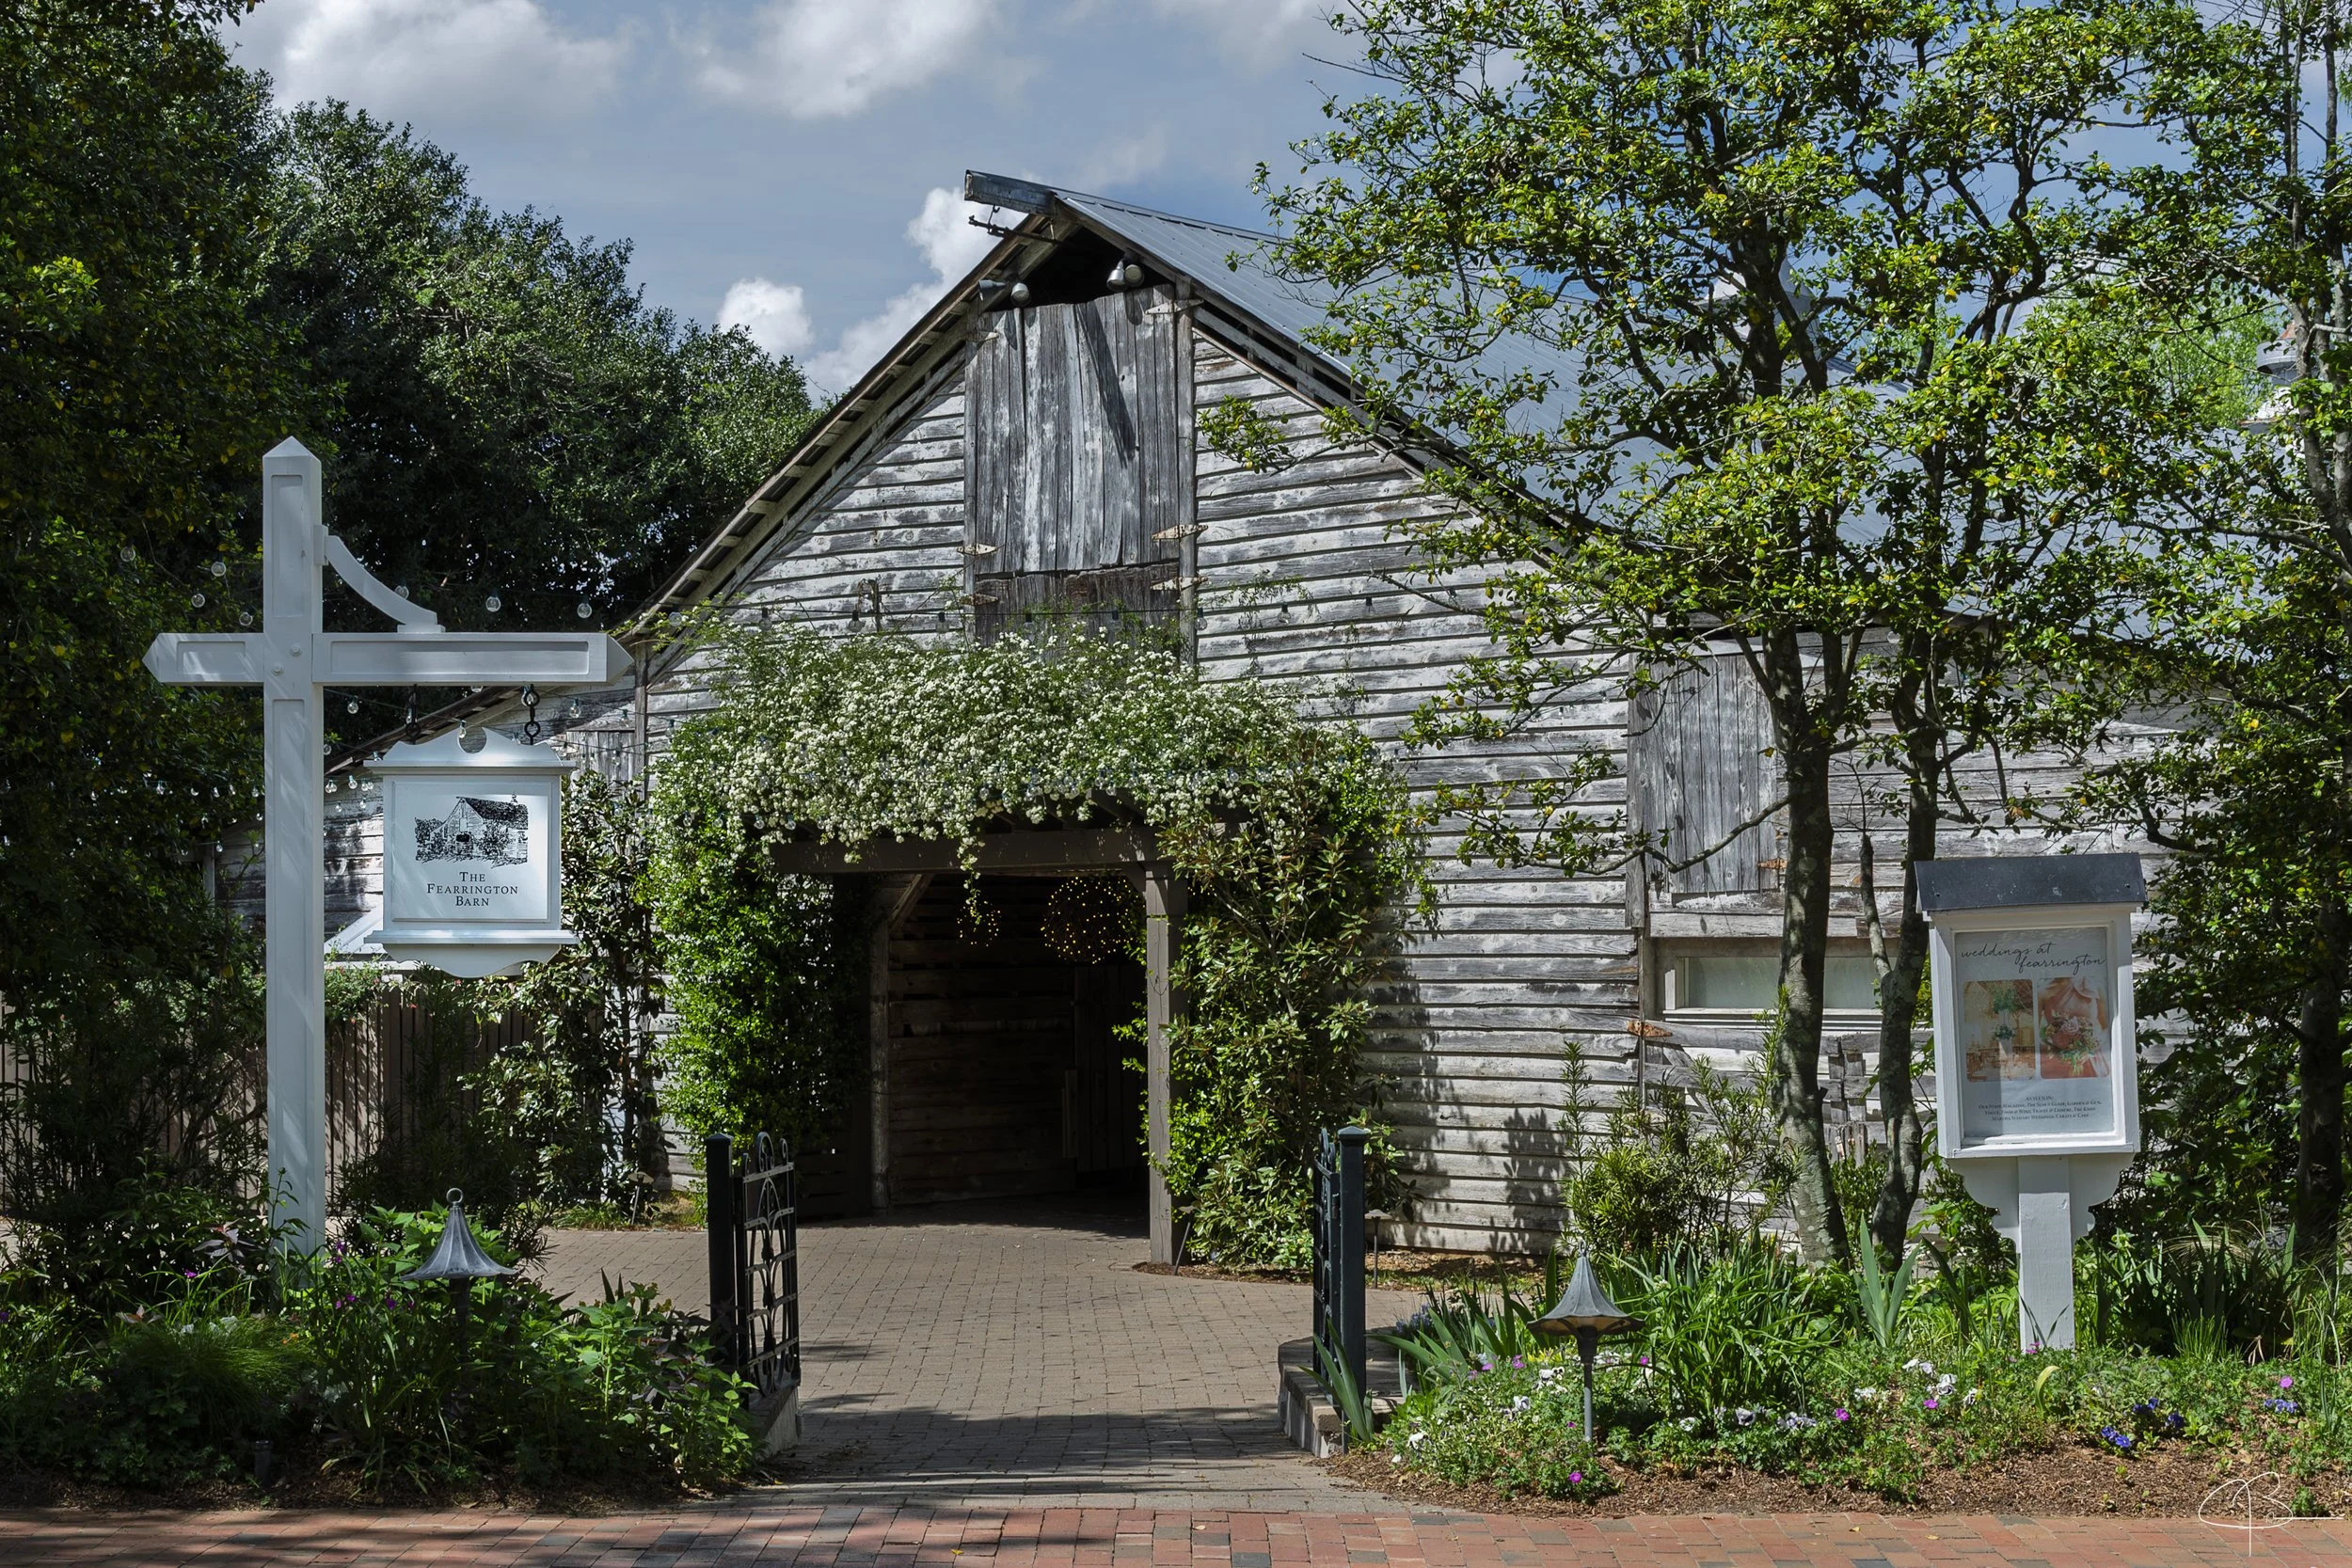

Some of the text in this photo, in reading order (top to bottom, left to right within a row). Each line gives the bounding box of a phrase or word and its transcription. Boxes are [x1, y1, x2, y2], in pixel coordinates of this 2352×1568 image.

[459, 871, 485, 882] THE
[427, 883, 518, 895] FEARRINGTON
[455, 895, 489, 907] BARN
[1961, 942, 2056, 965] weddings at
[2018, 954, 2106, 974] fearrington
